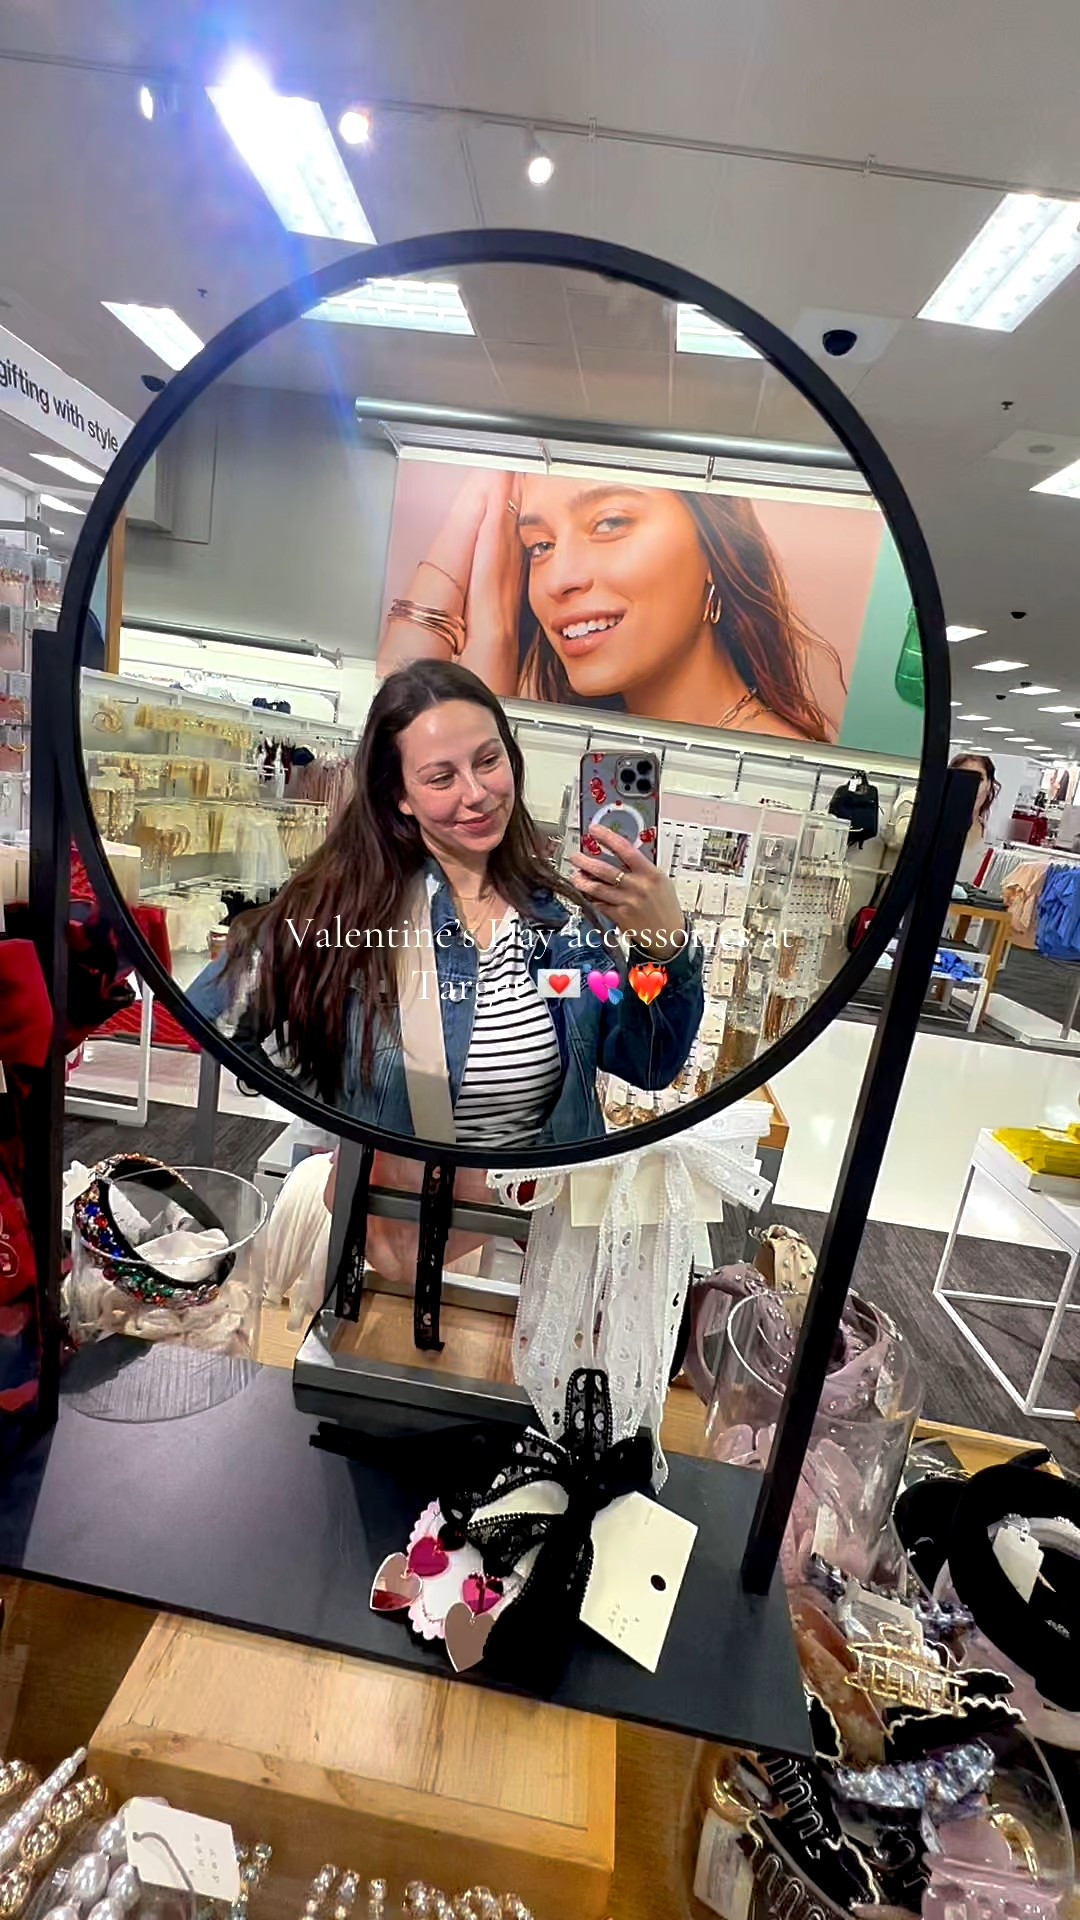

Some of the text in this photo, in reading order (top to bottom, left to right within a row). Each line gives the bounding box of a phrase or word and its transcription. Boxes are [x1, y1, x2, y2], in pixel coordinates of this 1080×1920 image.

[0, 358, 119, 453] gifting with style
